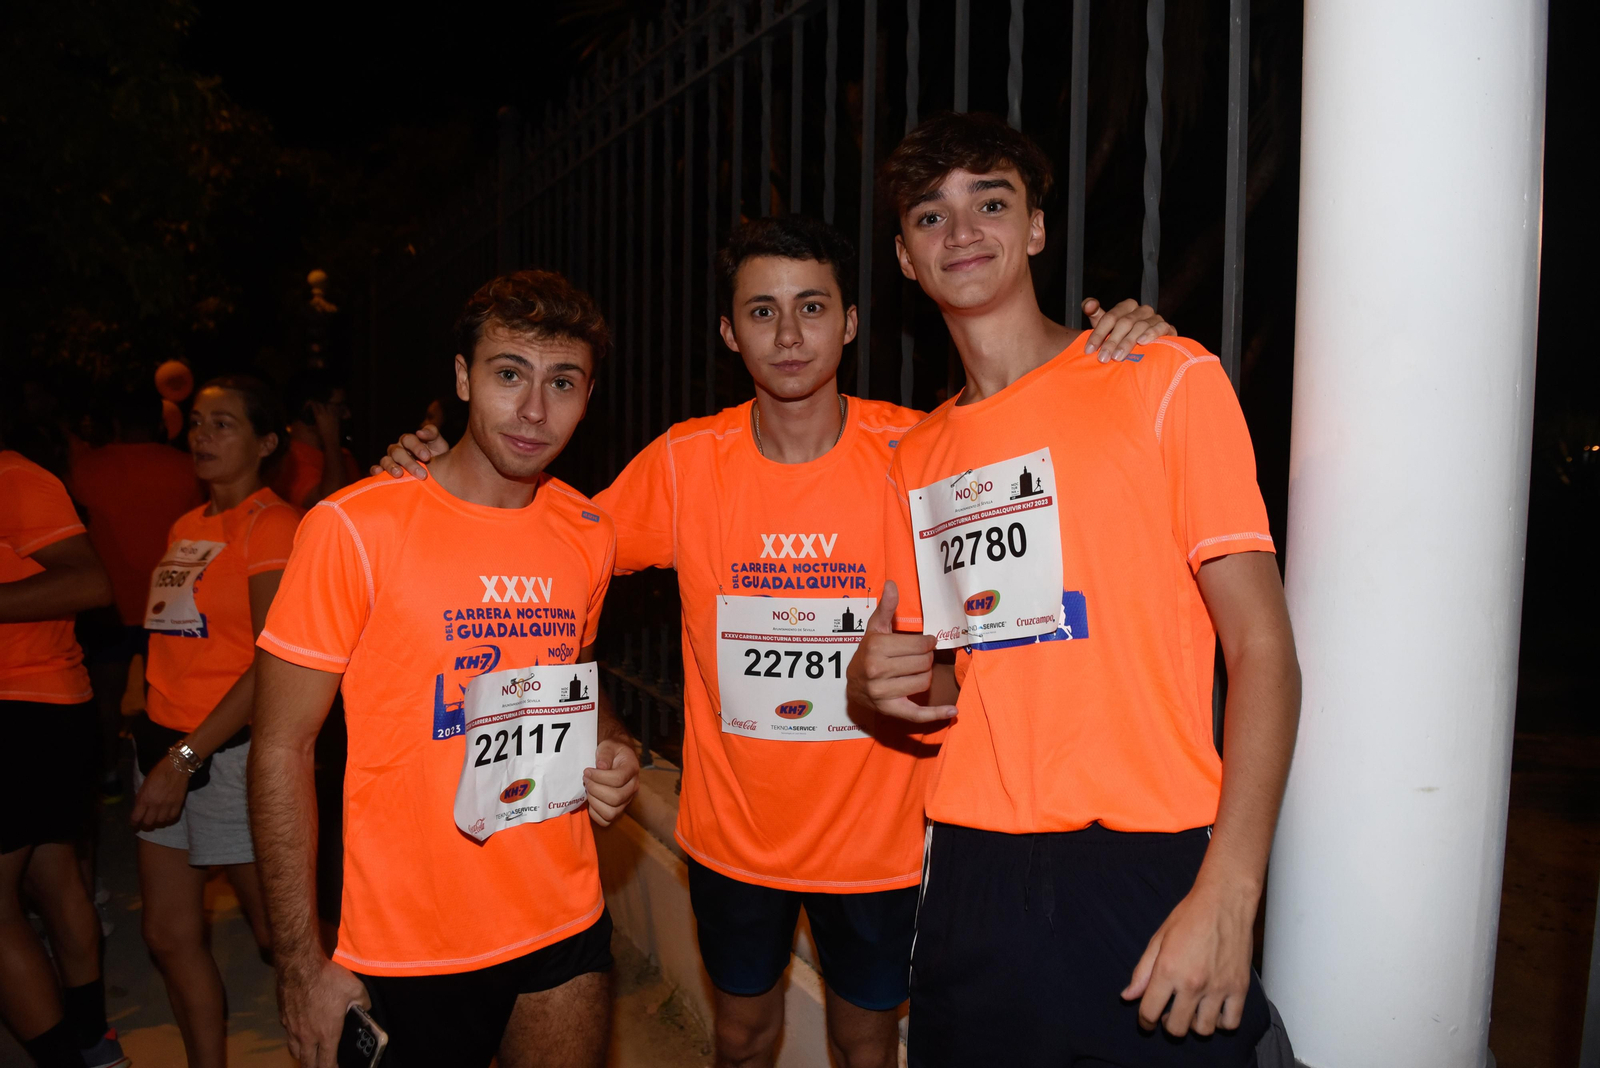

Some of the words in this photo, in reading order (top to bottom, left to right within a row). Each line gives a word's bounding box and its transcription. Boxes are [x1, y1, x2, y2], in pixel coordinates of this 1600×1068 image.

[981, 504, 1022, 518] GUADALQUIVIR
[1035, 498, 1049, 506] 2023
[760, 533, 838, 558] XXXV
[940, 522, 1027, 574] 22780
[731, 563, 787, 573] CARRERA
[793, 563, 867, 573] NOCTURNA
[479, 575, 552, 603] XXXV
[741, 575, 866, 589] GUADALQUIVIR
[443, 608, 512, 621] CARRERA
[516, 608, 576, 620] NOCTURNA
[1016, 614, 1054, 627] Cruzcampo
[445, 623, 453, 641] DEL
[457, 622, 576, 639] GUADALQUIVIR
[744, 648, 841, 679] 22781
[526, 706, 570, 715] GUADALQUIVIR
[437, 725, 461, 738] 2023
[474, 722, 571, 768] 22117
